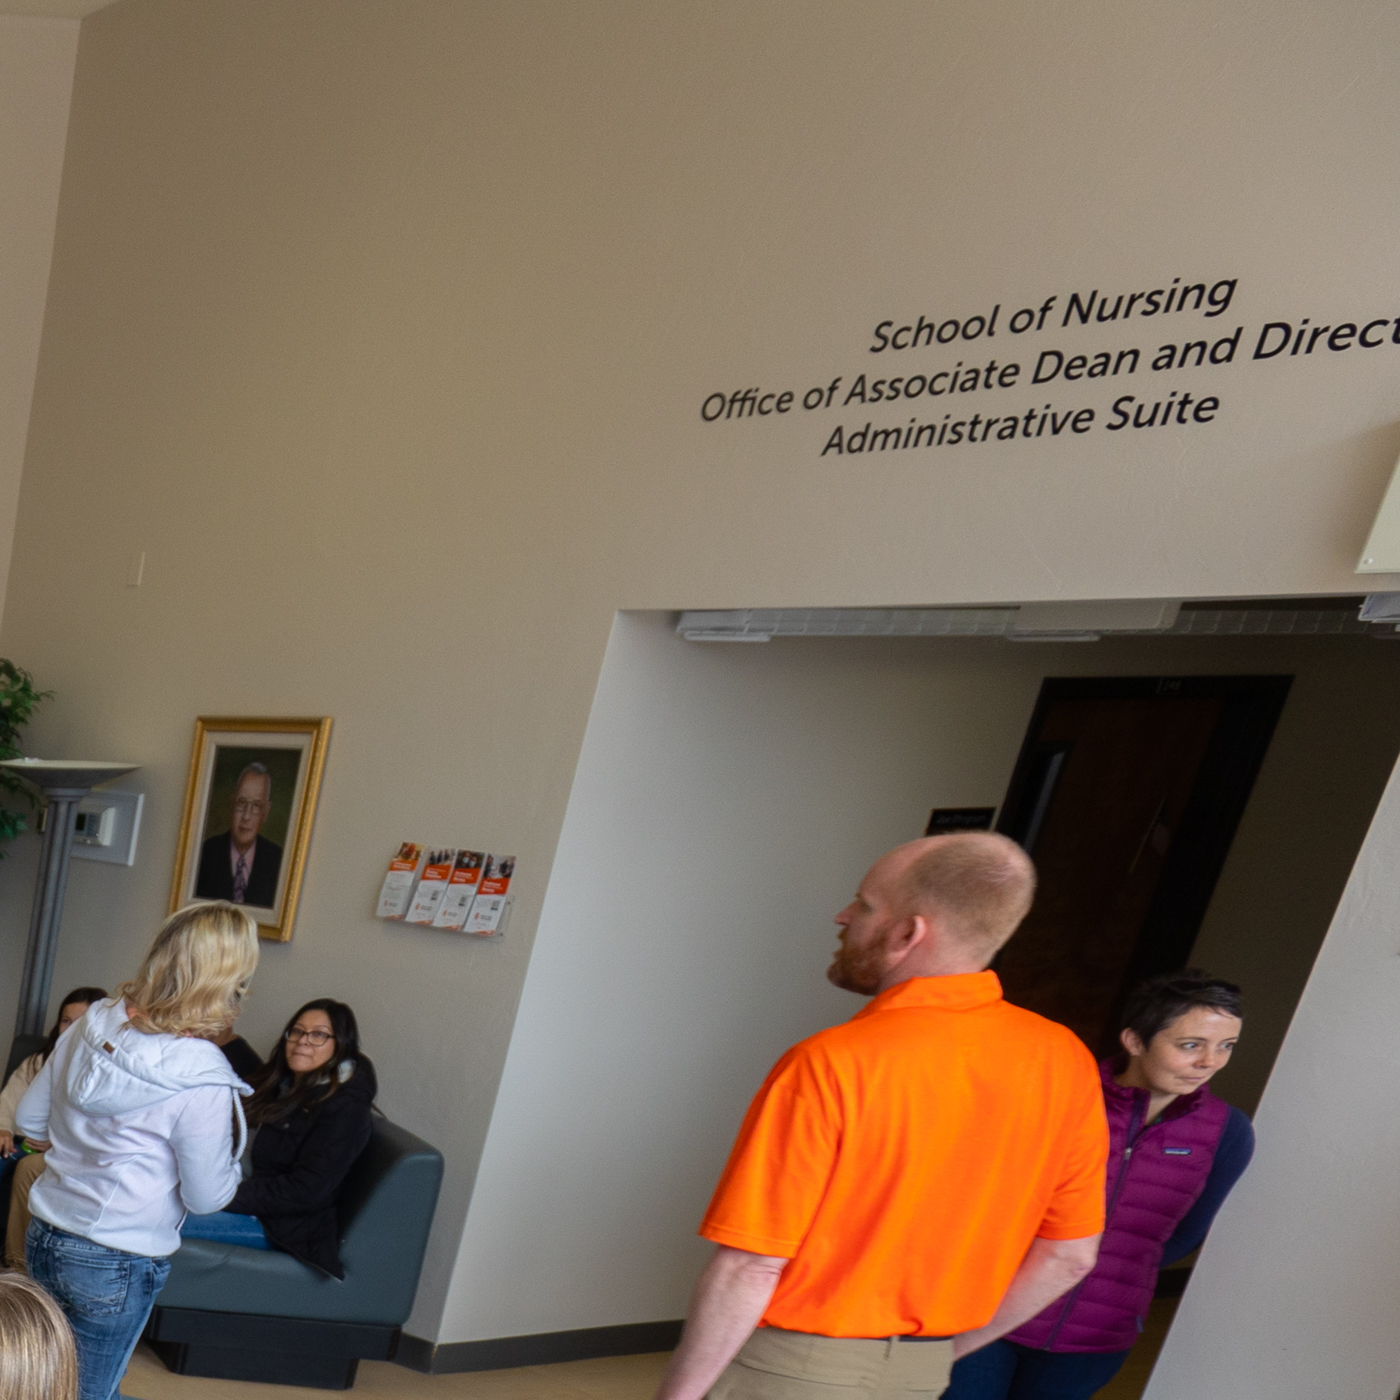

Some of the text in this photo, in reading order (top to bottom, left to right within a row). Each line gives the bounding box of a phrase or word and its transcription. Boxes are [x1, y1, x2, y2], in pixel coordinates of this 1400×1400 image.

[869, 278, 1238, 354] School of Nursing
[700, 388, 794, 423] Office
[802, 378, 840, 411] of
[844, 361, 1021, 407] Associate
[1032, 345, 1140, 385] Dean
[1151, 328, 1241, 372] and
[820, 392, 1219, 456] Administrative Suite
